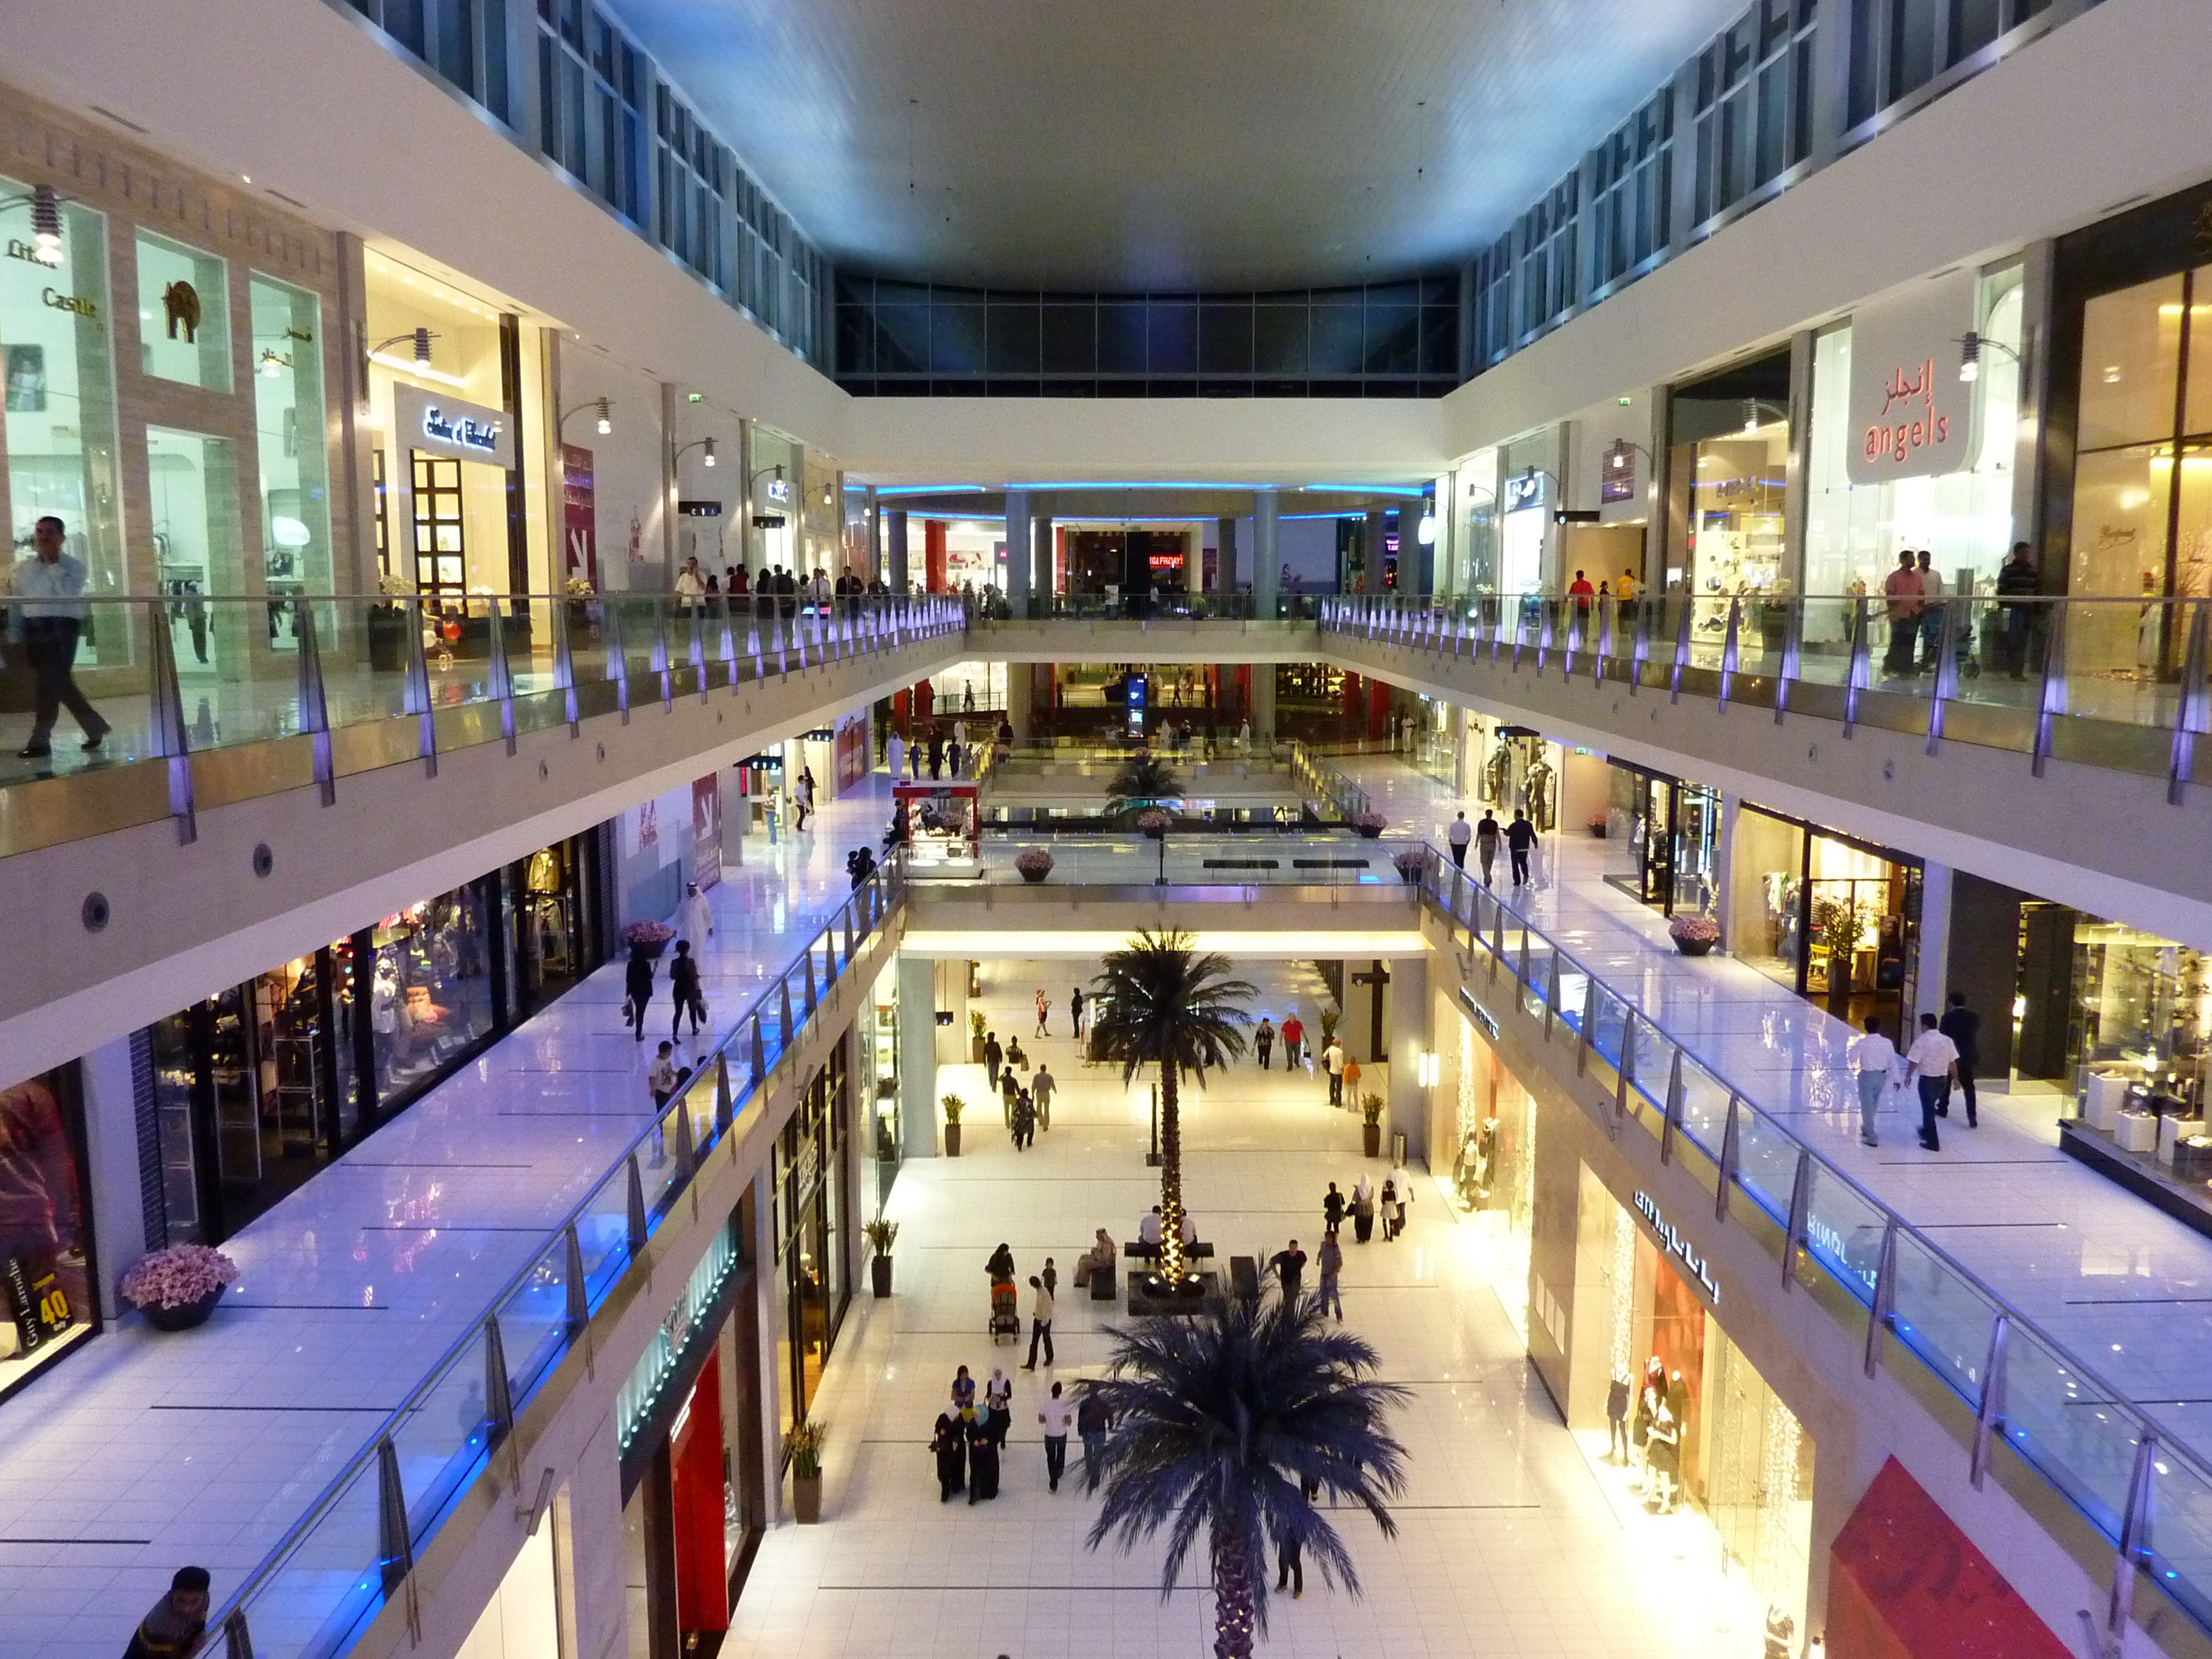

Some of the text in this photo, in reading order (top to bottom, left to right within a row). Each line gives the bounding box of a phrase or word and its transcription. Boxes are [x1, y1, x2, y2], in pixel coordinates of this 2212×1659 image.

[1881, 358, 1933, 416] إنجلز
[1864, 406, 1949, 463] angels
[9, 1257, 39, 1347] Guy Laroche
[41, 1290, 69, 1325] 40
